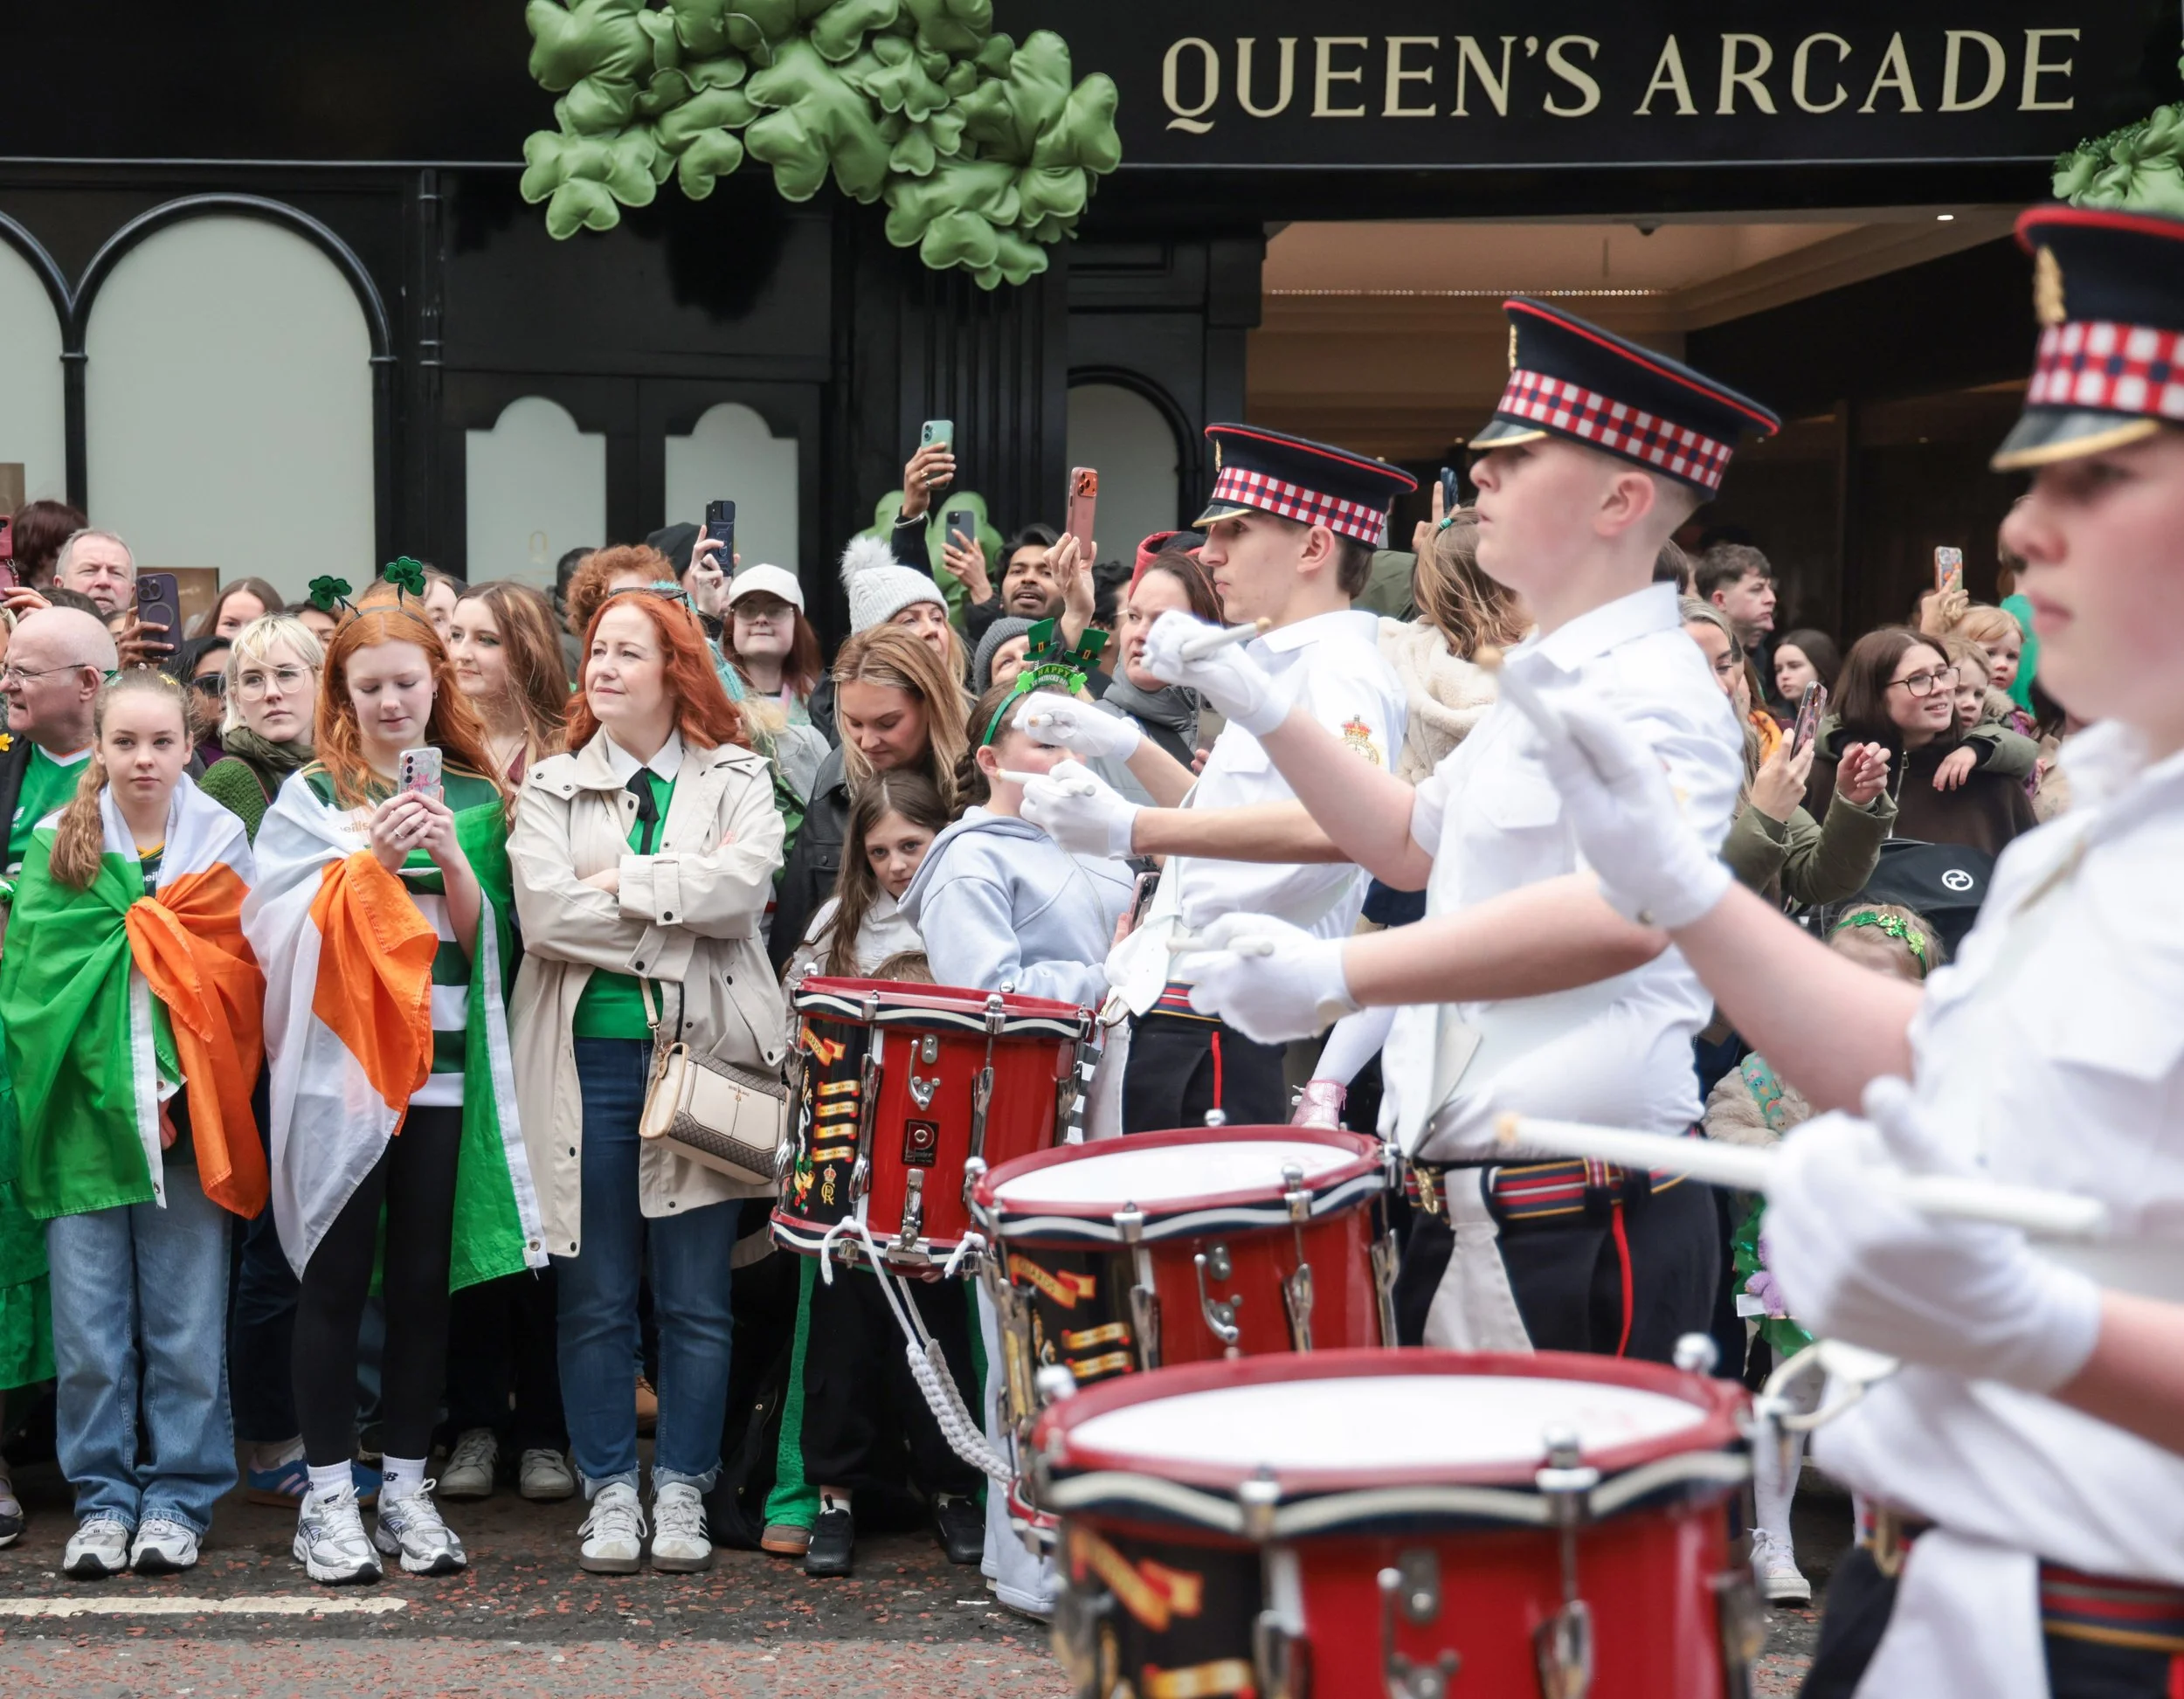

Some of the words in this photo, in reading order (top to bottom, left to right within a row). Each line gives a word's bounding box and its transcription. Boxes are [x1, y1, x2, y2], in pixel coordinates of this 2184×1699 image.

[1162, 35, 1600, 134] QUEEN'S
[1634, 28, 2080, 115] ARCADE
[1038, 666, 1070, 677] HAPPY
[805, 1030, 822, 1054] GUARDS
[600, 1490, 617, 1500] adidas
[680, 1490, 696, 1501] adidas
